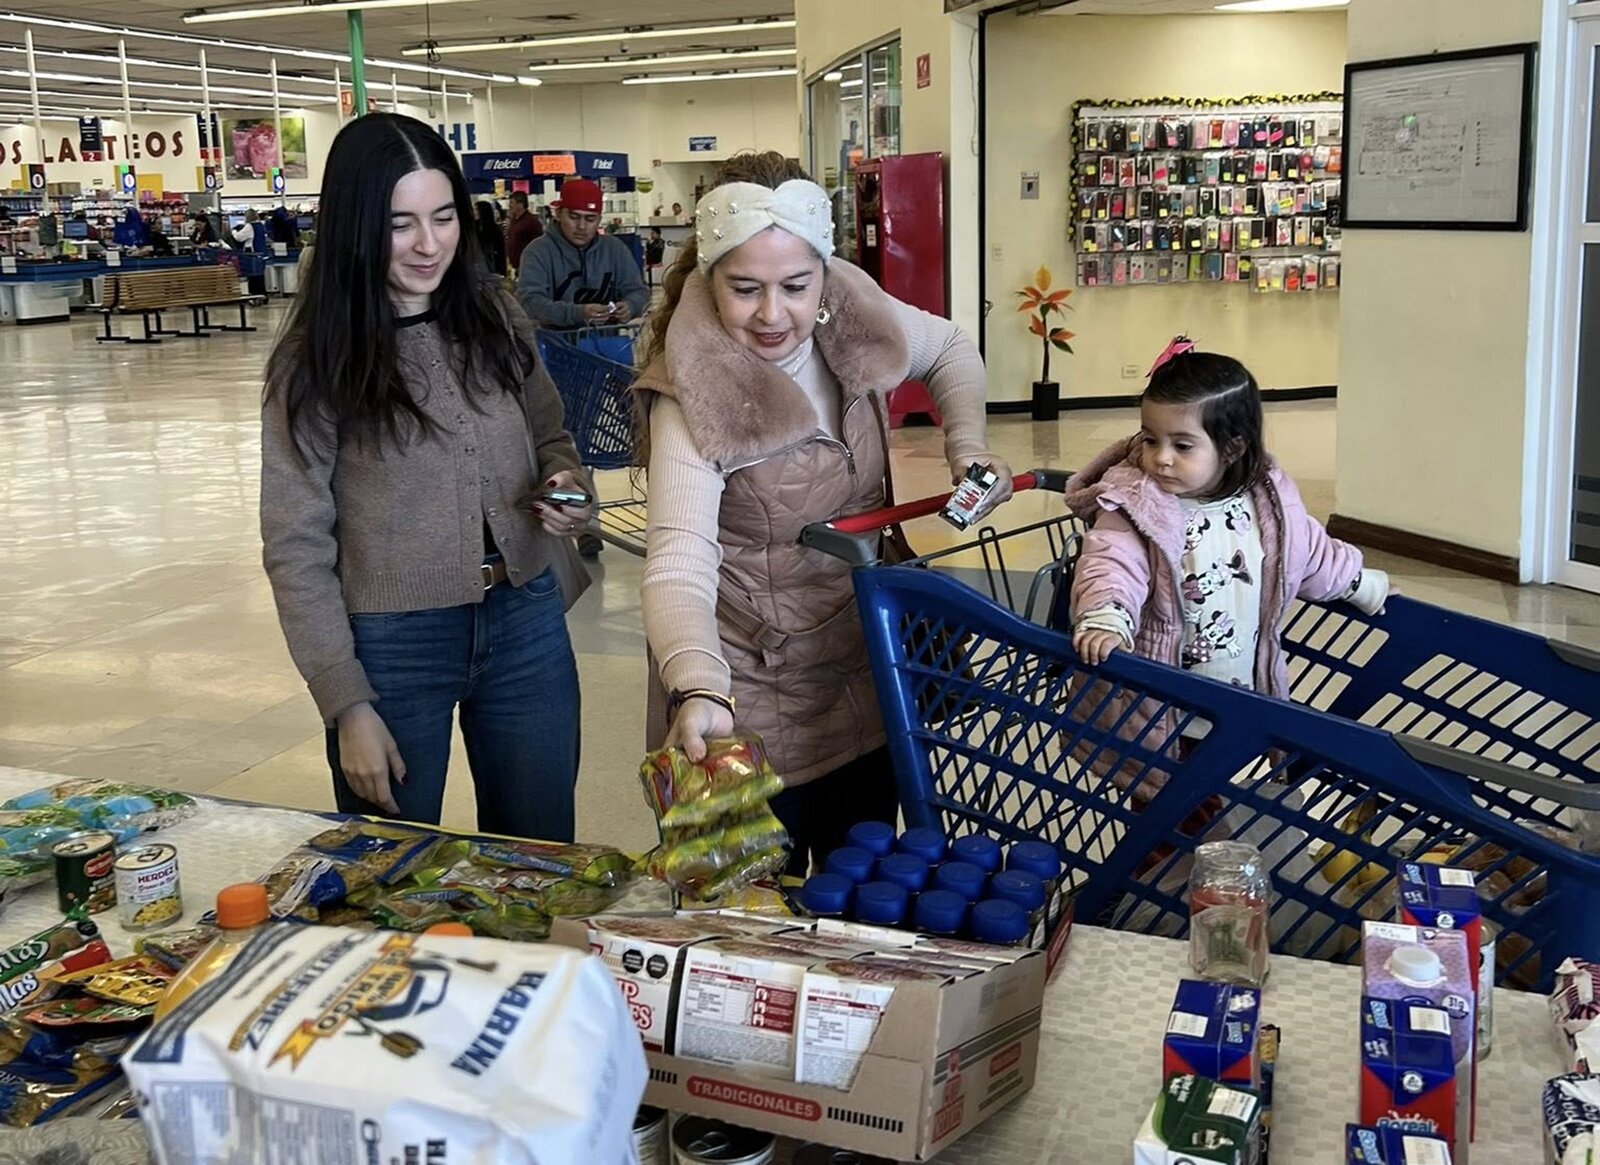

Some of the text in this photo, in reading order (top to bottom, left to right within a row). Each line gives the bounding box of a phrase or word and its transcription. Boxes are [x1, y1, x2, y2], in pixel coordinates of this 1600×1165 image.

[0, 141, 21, 165] S
[42, 131, 183, 163] LATEOS
[88, 151, 96, 162] 2
[493, 157, 523, 170] telcel
[137, 866, 175, 884] HERDEZ
[317, 973, 385, 1030] TRIGO
[450, 970, 548, 1077] HARINA
[692, 1080, 815, 1118] TRADICIONALES
